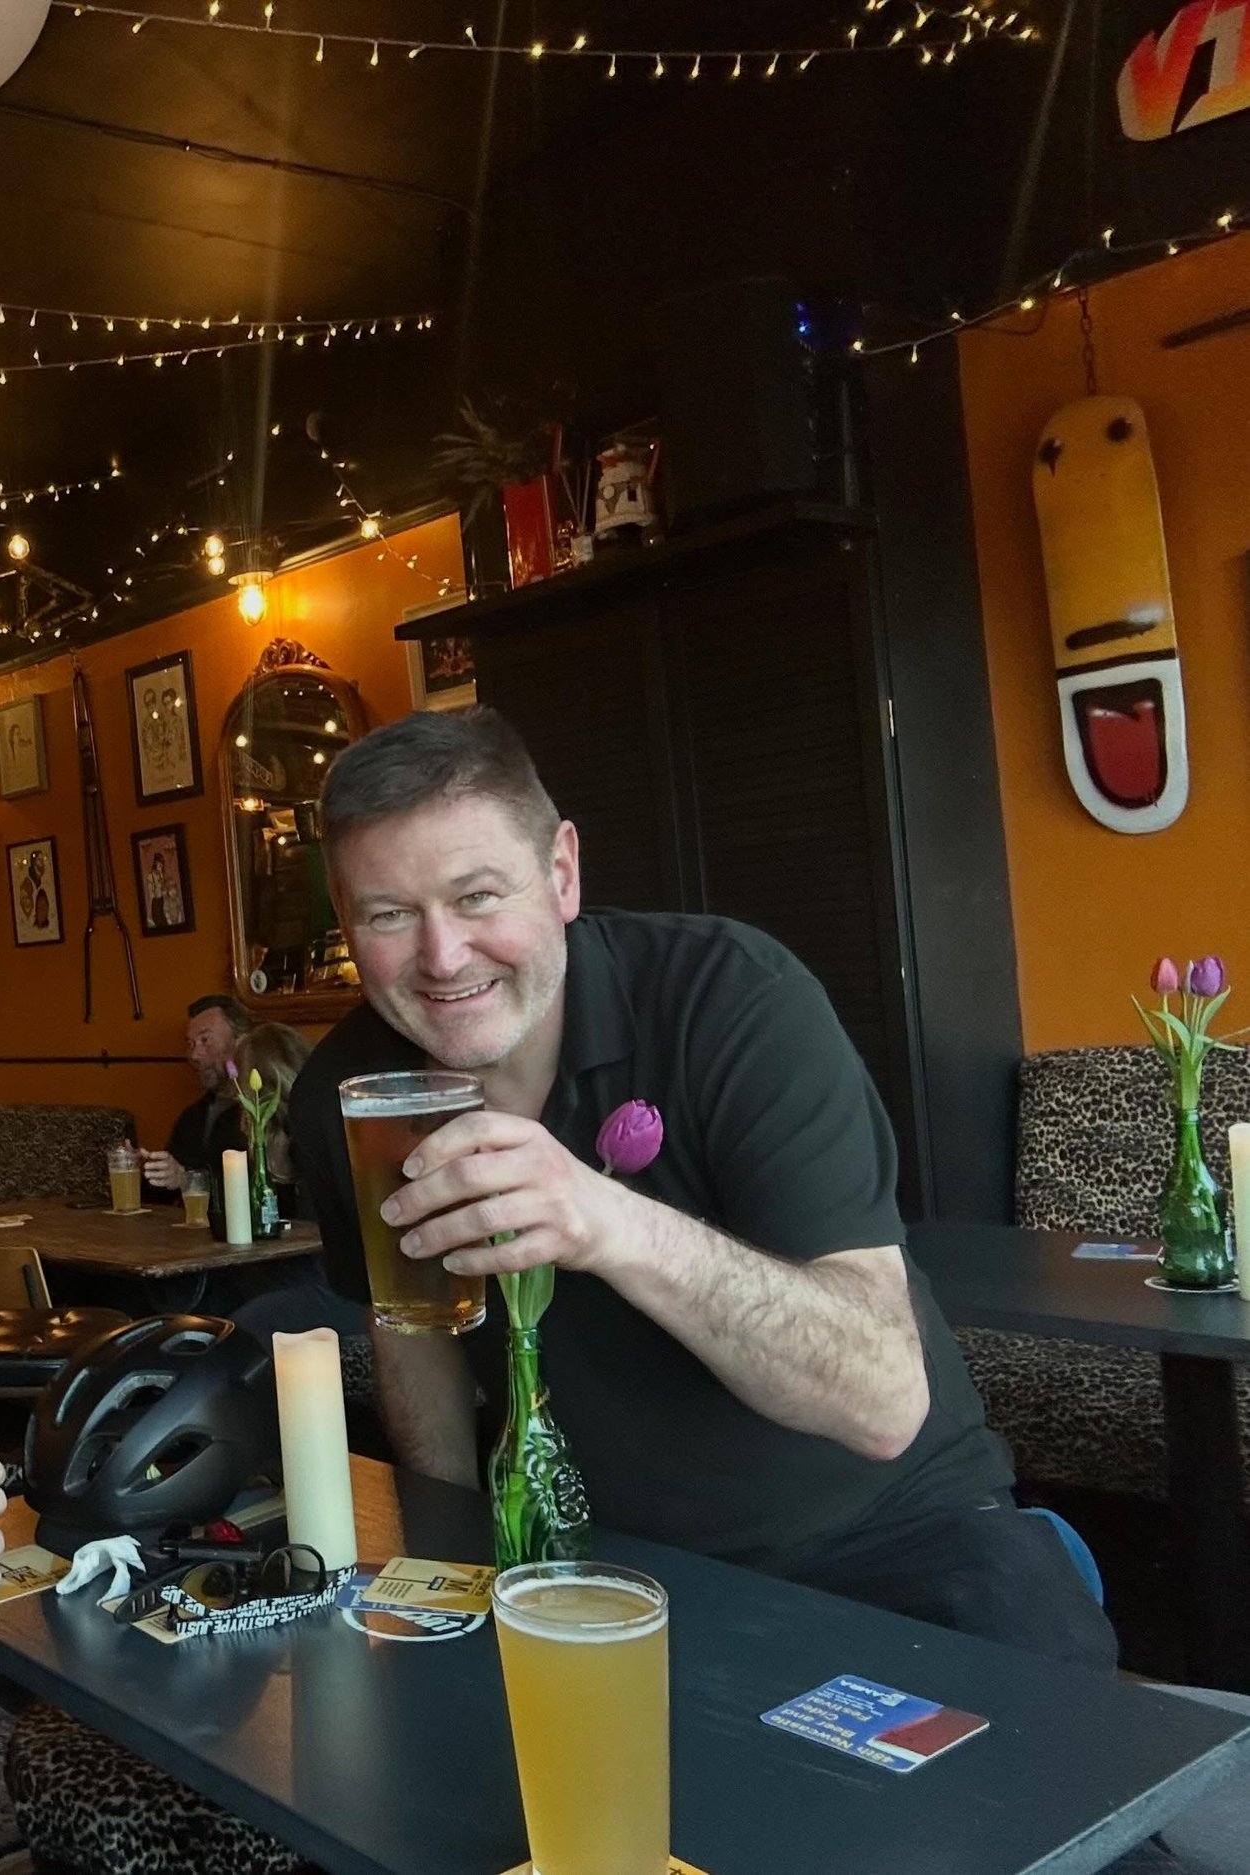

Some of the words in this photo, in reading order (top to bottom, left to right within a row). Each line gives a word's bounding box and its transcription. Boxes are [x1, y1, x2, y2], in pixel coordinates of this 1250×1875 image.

[213, 1613, 280, 1634] JUSTHYPE
[780, 1707, 816, 1723] and
[796, 1702, 839, 1721] Cider
[808, 1694, 873, 1723] Festival
[770, 1714, 854, 1750] Newcastle
[817, 1721, 857, 1739] Beer
